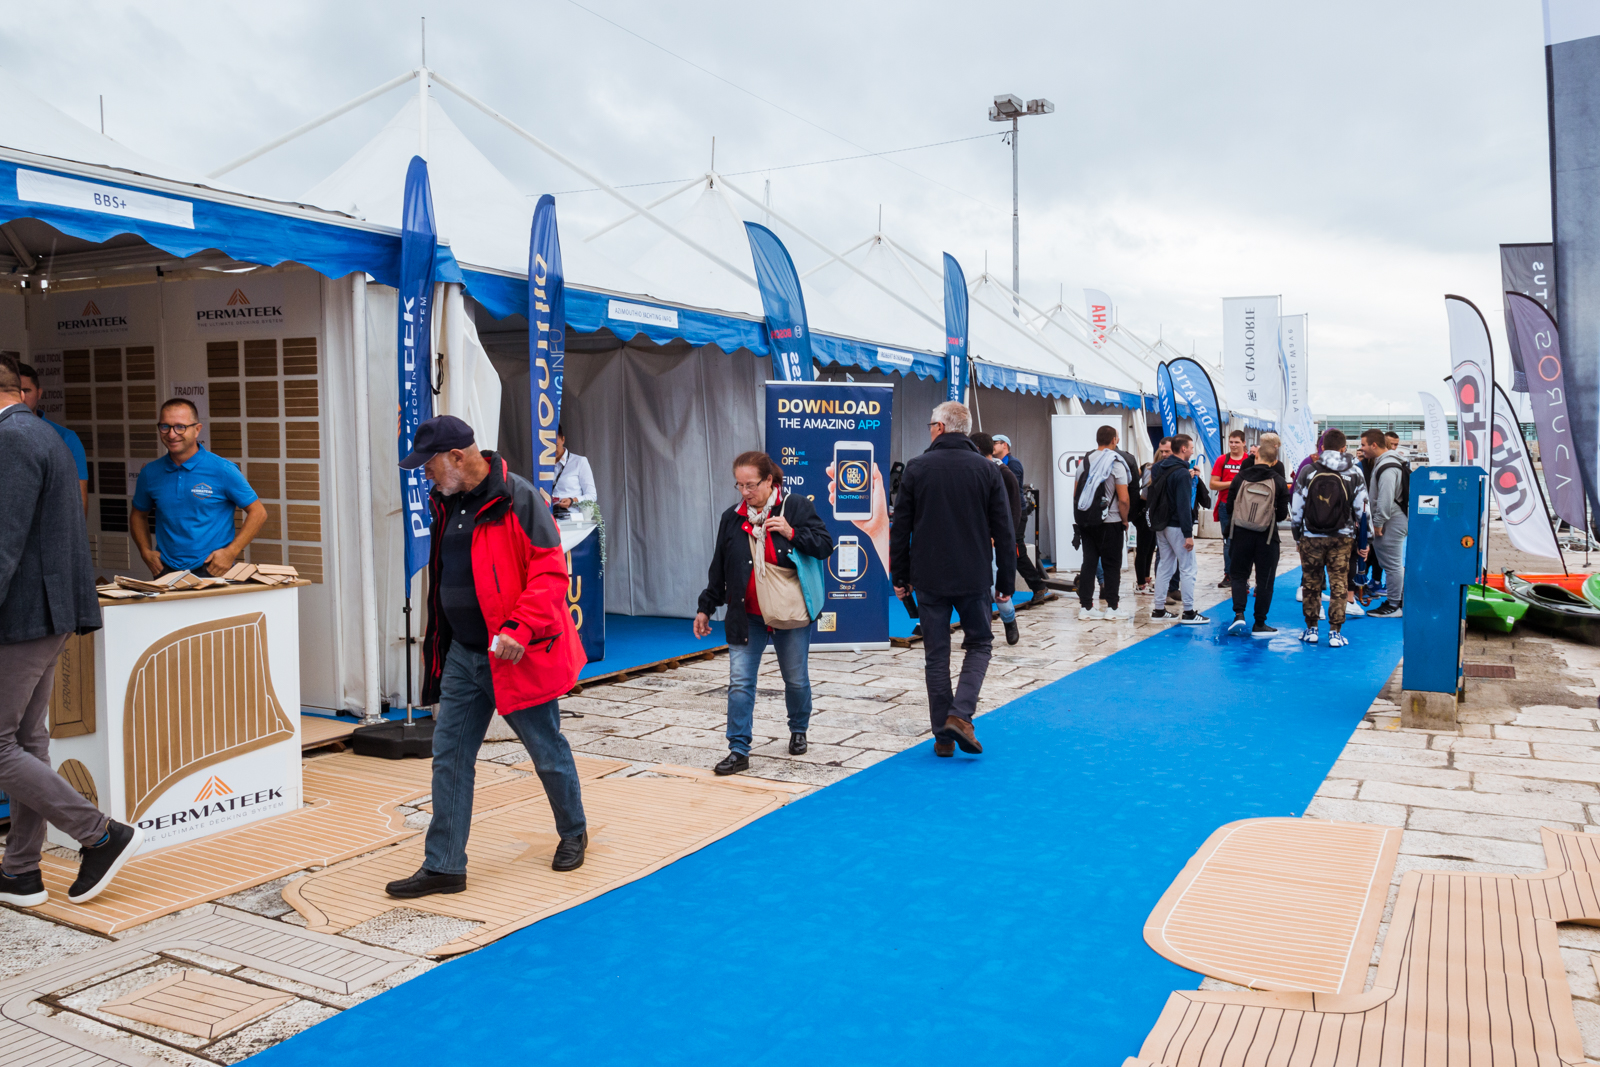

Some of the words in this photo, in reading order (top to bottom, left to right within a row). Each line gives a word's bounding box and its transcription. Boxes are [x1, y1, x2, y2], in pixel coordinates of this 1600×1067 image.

[93, 192, 127, 210] BBS+
[196, 306, 282, 320] PERMATEEK
[57, 316, 128, 330] PERMATEEK
[777, 398, 881, 415] DOWNLOAD
[777, 417, 801, 429] THE
[803, 418, 855, 430] AMAZING
[857, 419, 881, 430] APP
[137, 786, 283, 830] PERMATEEK
[160, 822, 205, 839] ULTIMATE
[209, 811, 248, 826] DECKING
[251, 801, 284, 815] SYSTEM
